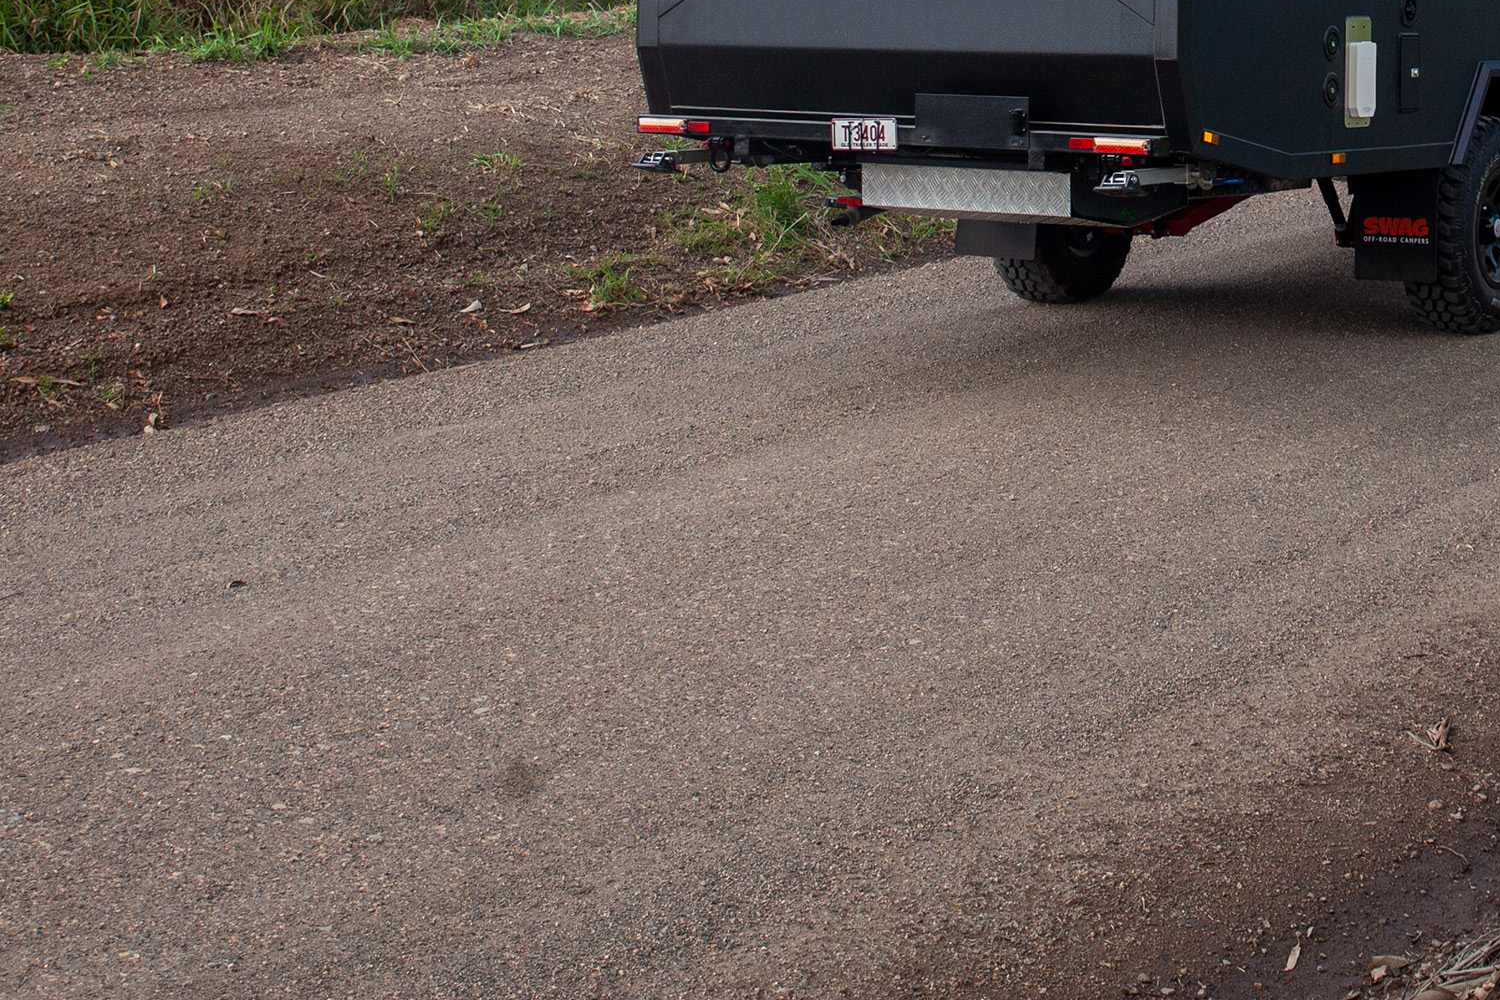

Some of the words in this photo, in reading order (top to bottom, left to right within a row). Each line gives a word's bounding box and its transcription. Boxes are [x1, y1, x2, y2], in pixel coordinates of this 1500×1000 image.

[1363, 216, 1429, 237] SWAG
[1363, 235, 1397, 243] OFF-ROAD
[1400, 236, 1429, 245] CAMPERS
